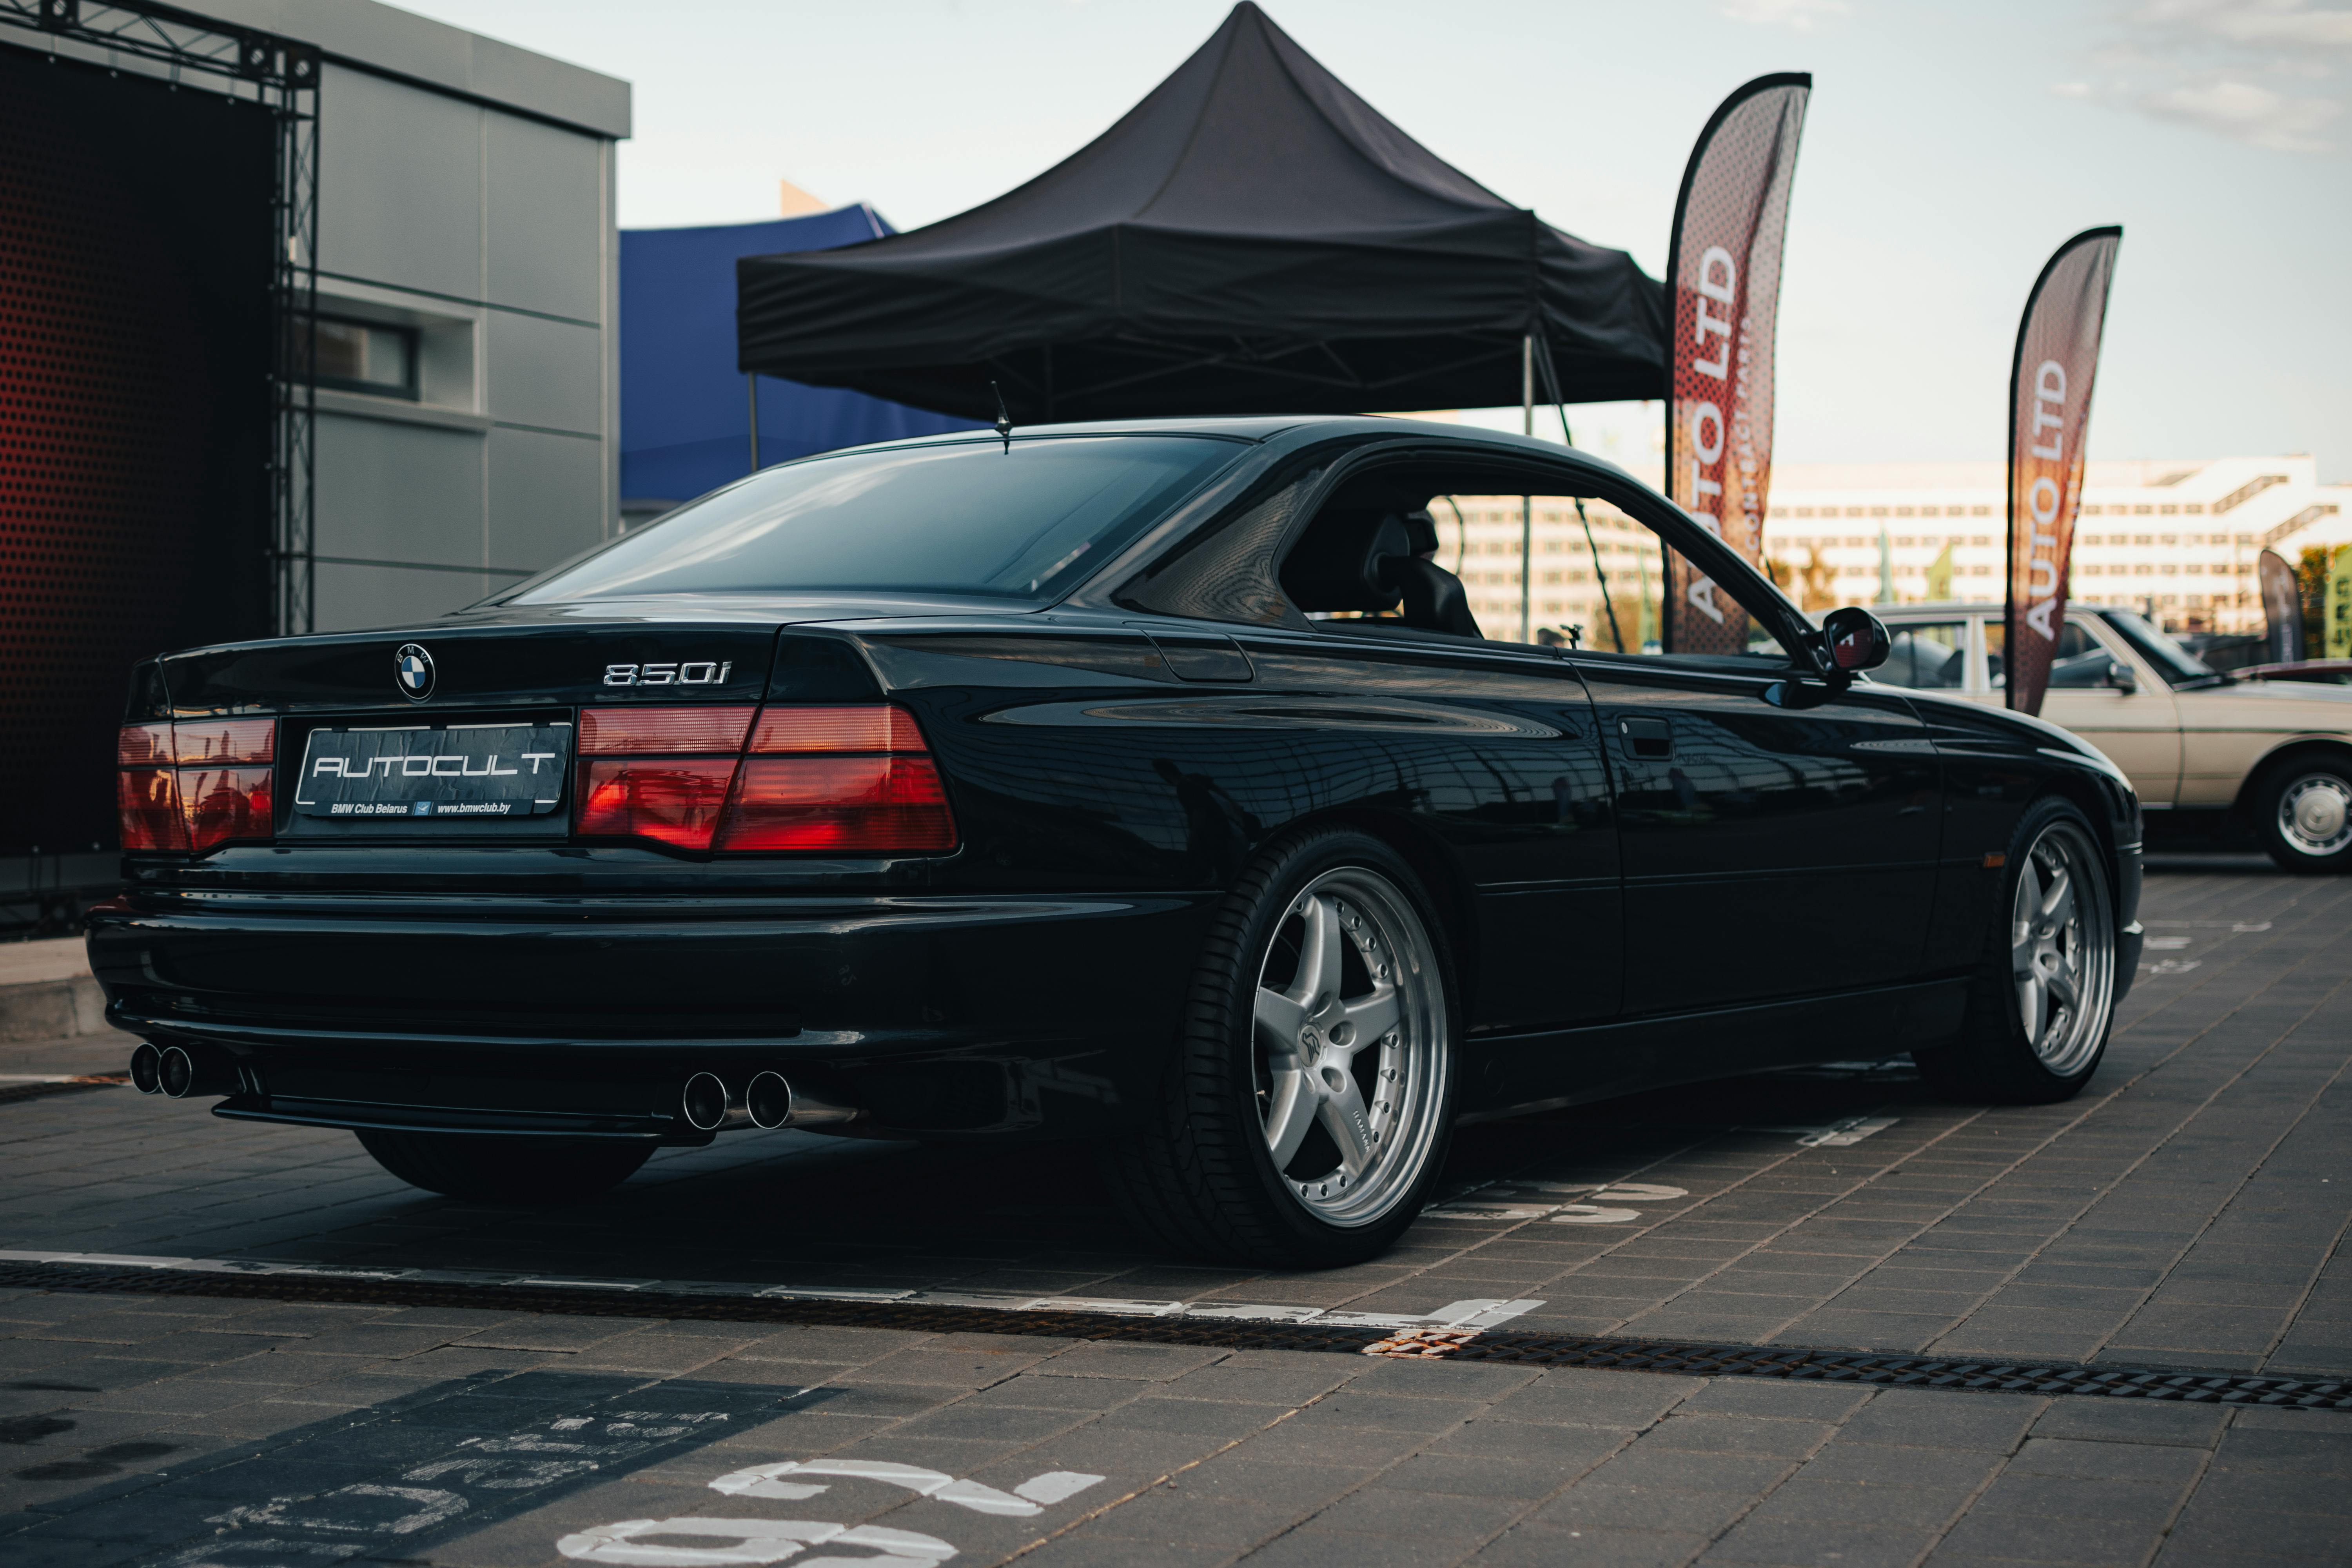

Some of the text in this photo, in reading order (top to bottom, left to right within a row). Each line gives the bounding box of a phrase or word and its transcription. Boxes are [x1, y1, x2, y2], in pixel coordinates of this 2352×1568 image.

[1694, 245, 1736, 381] LTD
[1734, 316, 1760, 551] CONTRACT PARTS
[2027, 359, 2067, 642] AUTO LTD
[397, 646, 429, 664] BMW
[603, 661, 732, 686] 850i
[313, 753, 555, 777] AUTOCULT
[331, 802, 511, 815] BMW Club Belarus www.bmwclub.by
[1353, 1110, 1370, 1153] HAMANN
